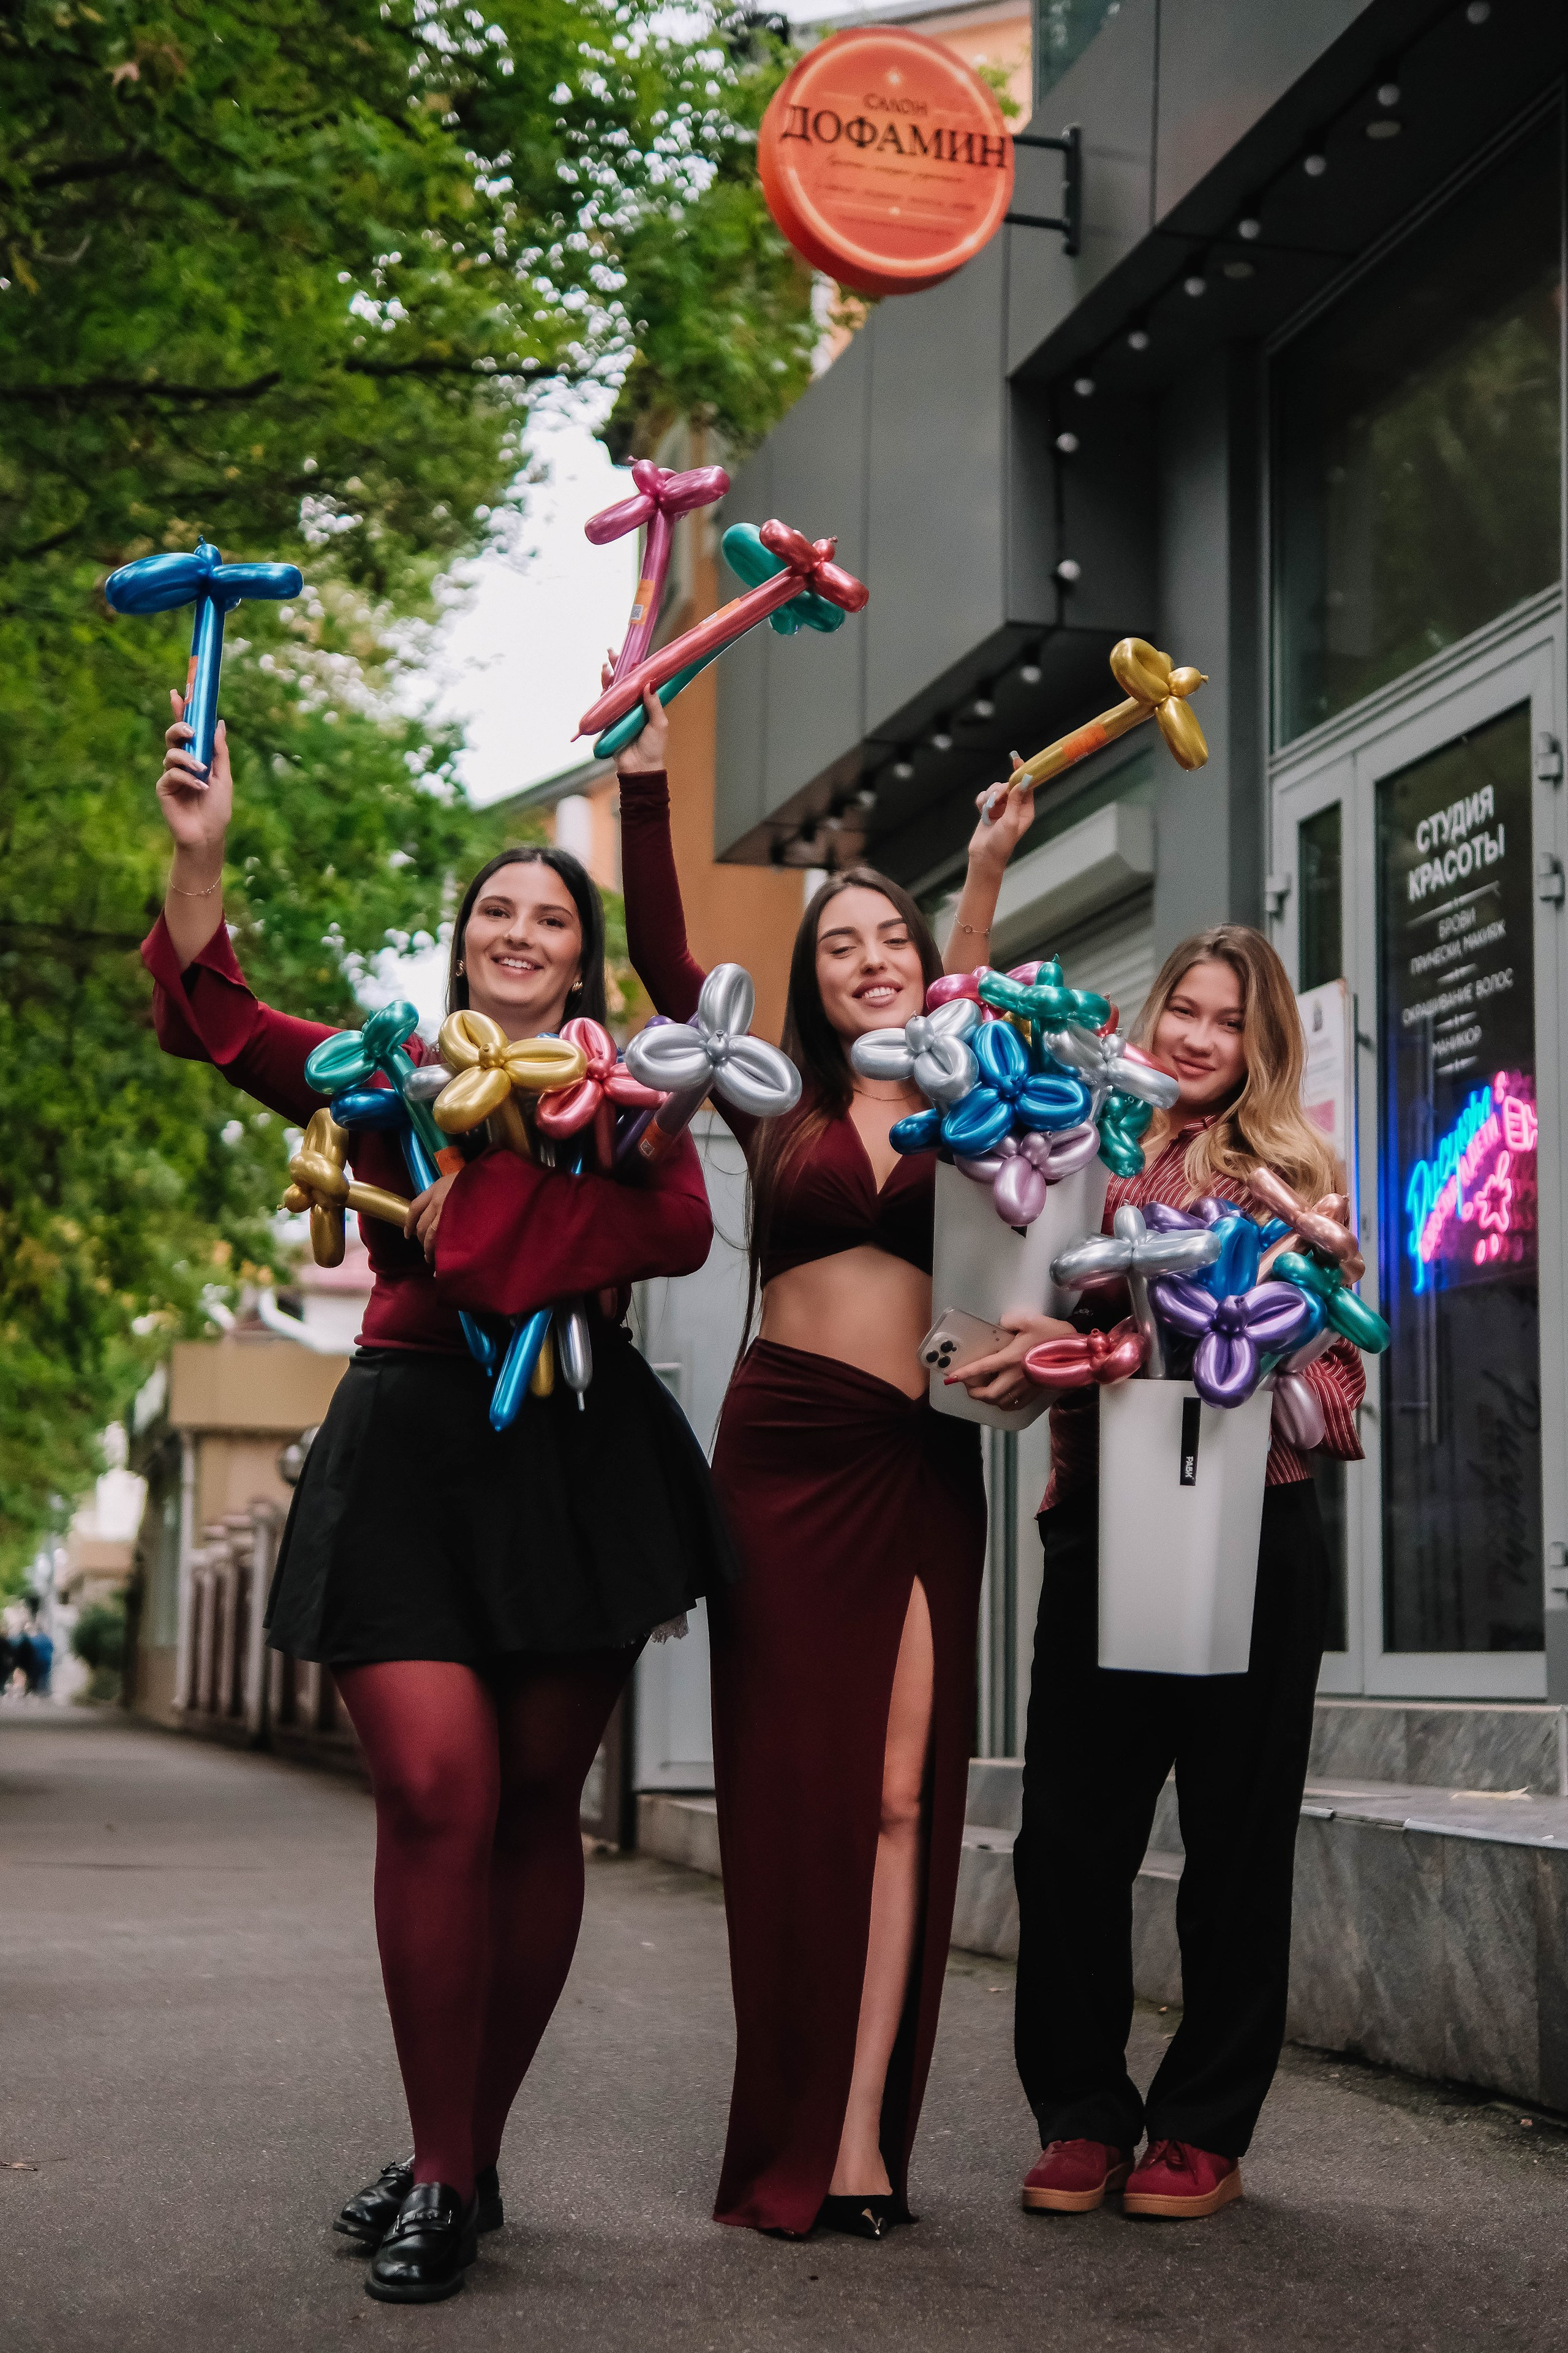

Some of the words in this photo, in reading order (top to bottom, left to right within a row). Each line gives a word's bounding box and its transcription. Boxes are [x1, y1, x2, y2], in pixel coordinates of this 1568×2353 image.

[779, 104, 1008, 168] ДОФАМИН
[1415, 784, 1494, 853] СТУДИЯ
[1408, 823, 1505, 902] КРАСОТЫ
[1476, 967, 1514, 1000] ВОЛОС
